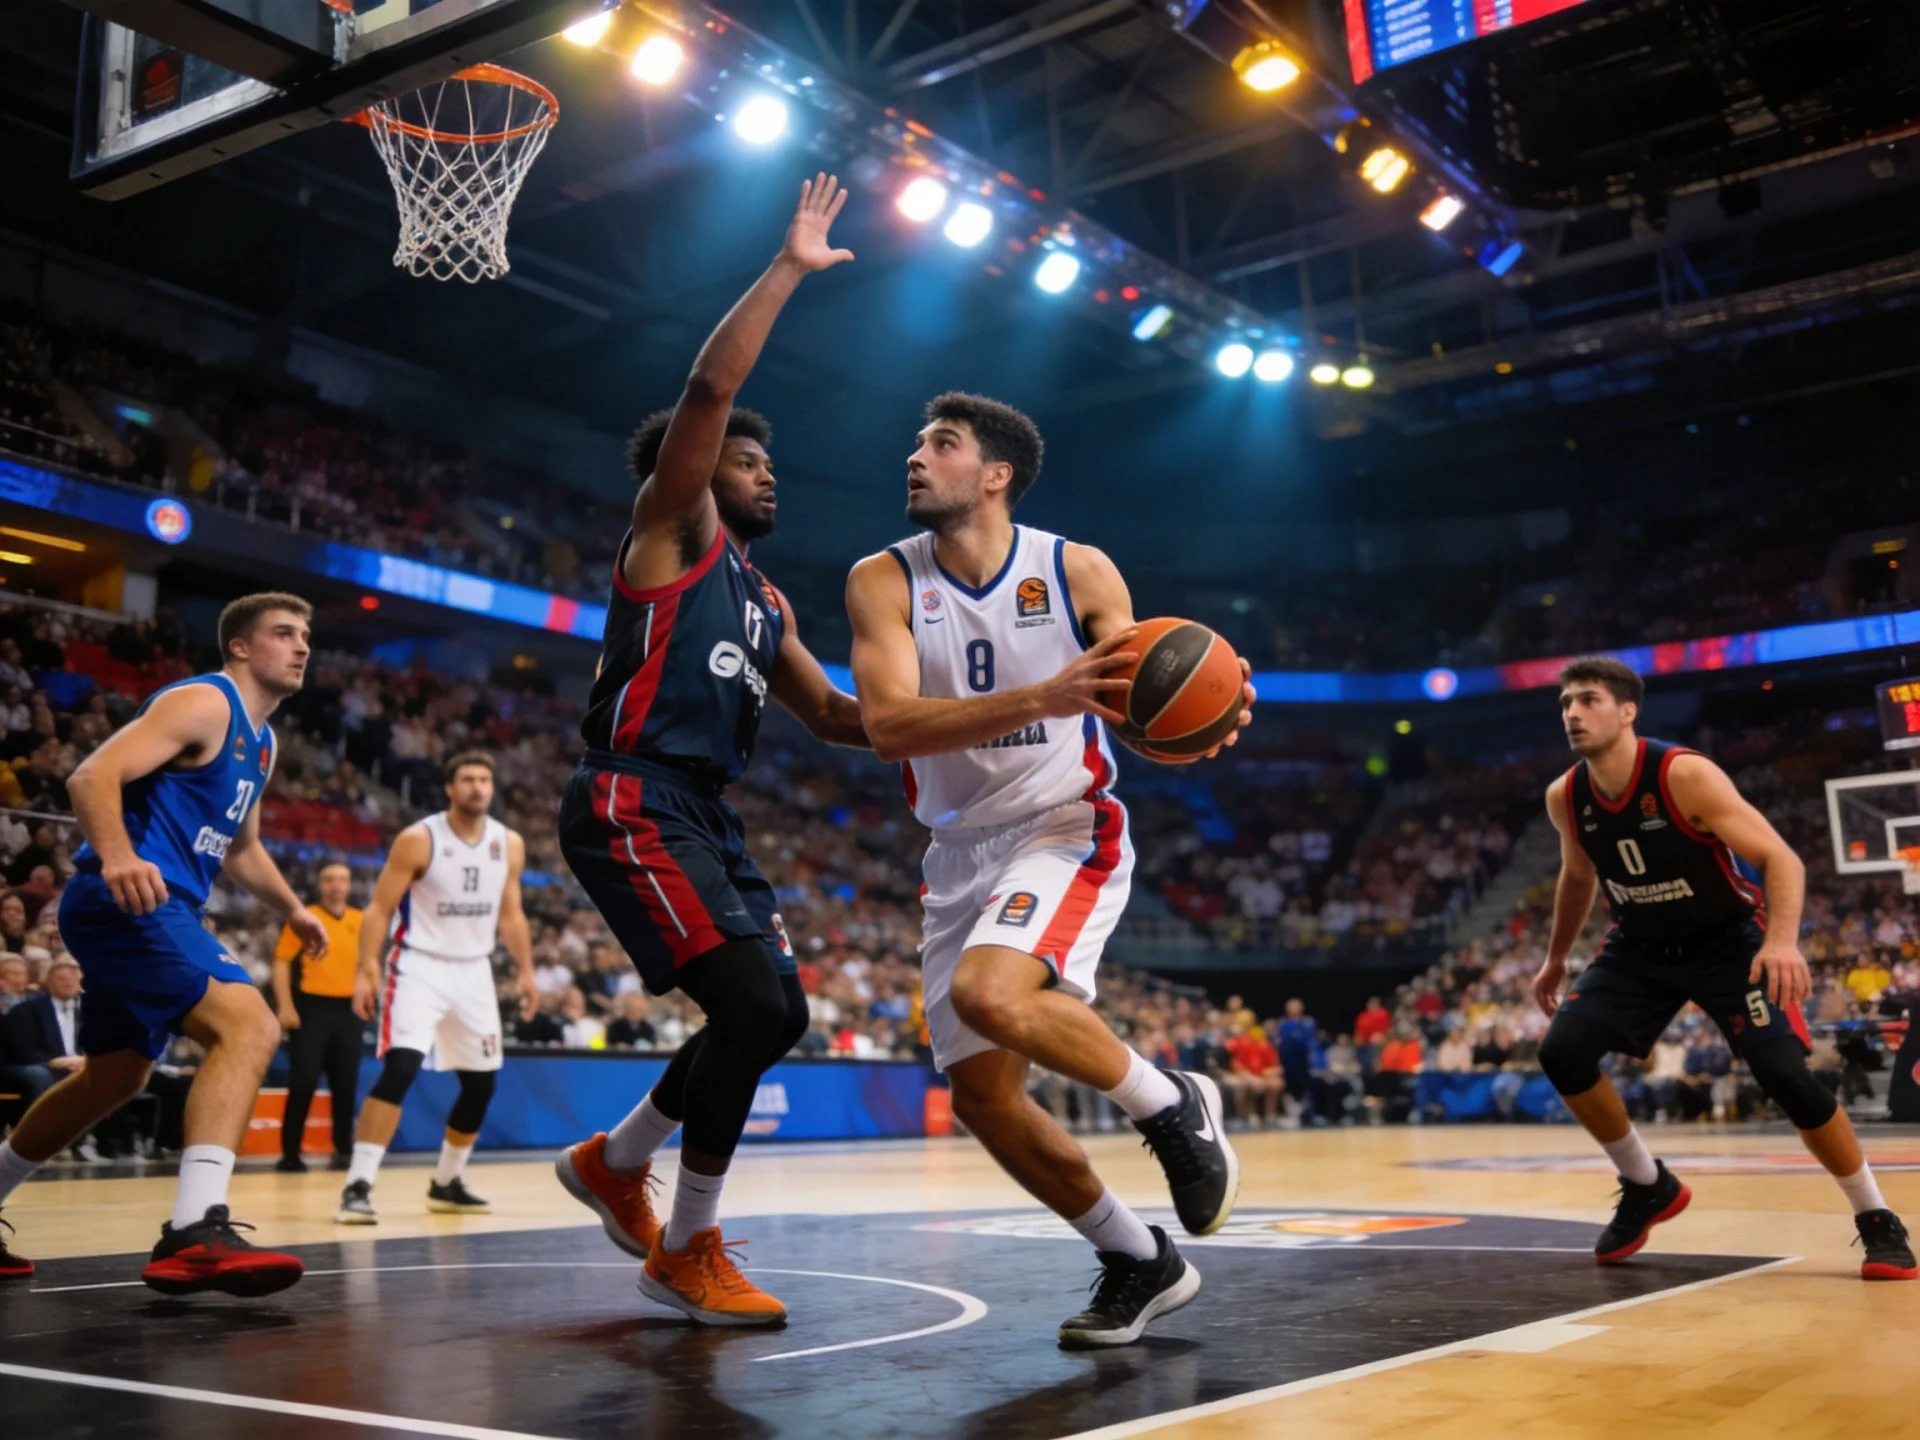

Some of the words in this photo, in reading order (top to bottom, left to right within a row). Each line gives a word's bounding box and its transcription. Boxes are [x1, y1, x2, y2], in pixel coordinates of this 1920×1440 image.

[966, 639, 995, 692] 8
[1617, 839, 1646, 876] 0
[1745, 990, 1771, 1027] 5
